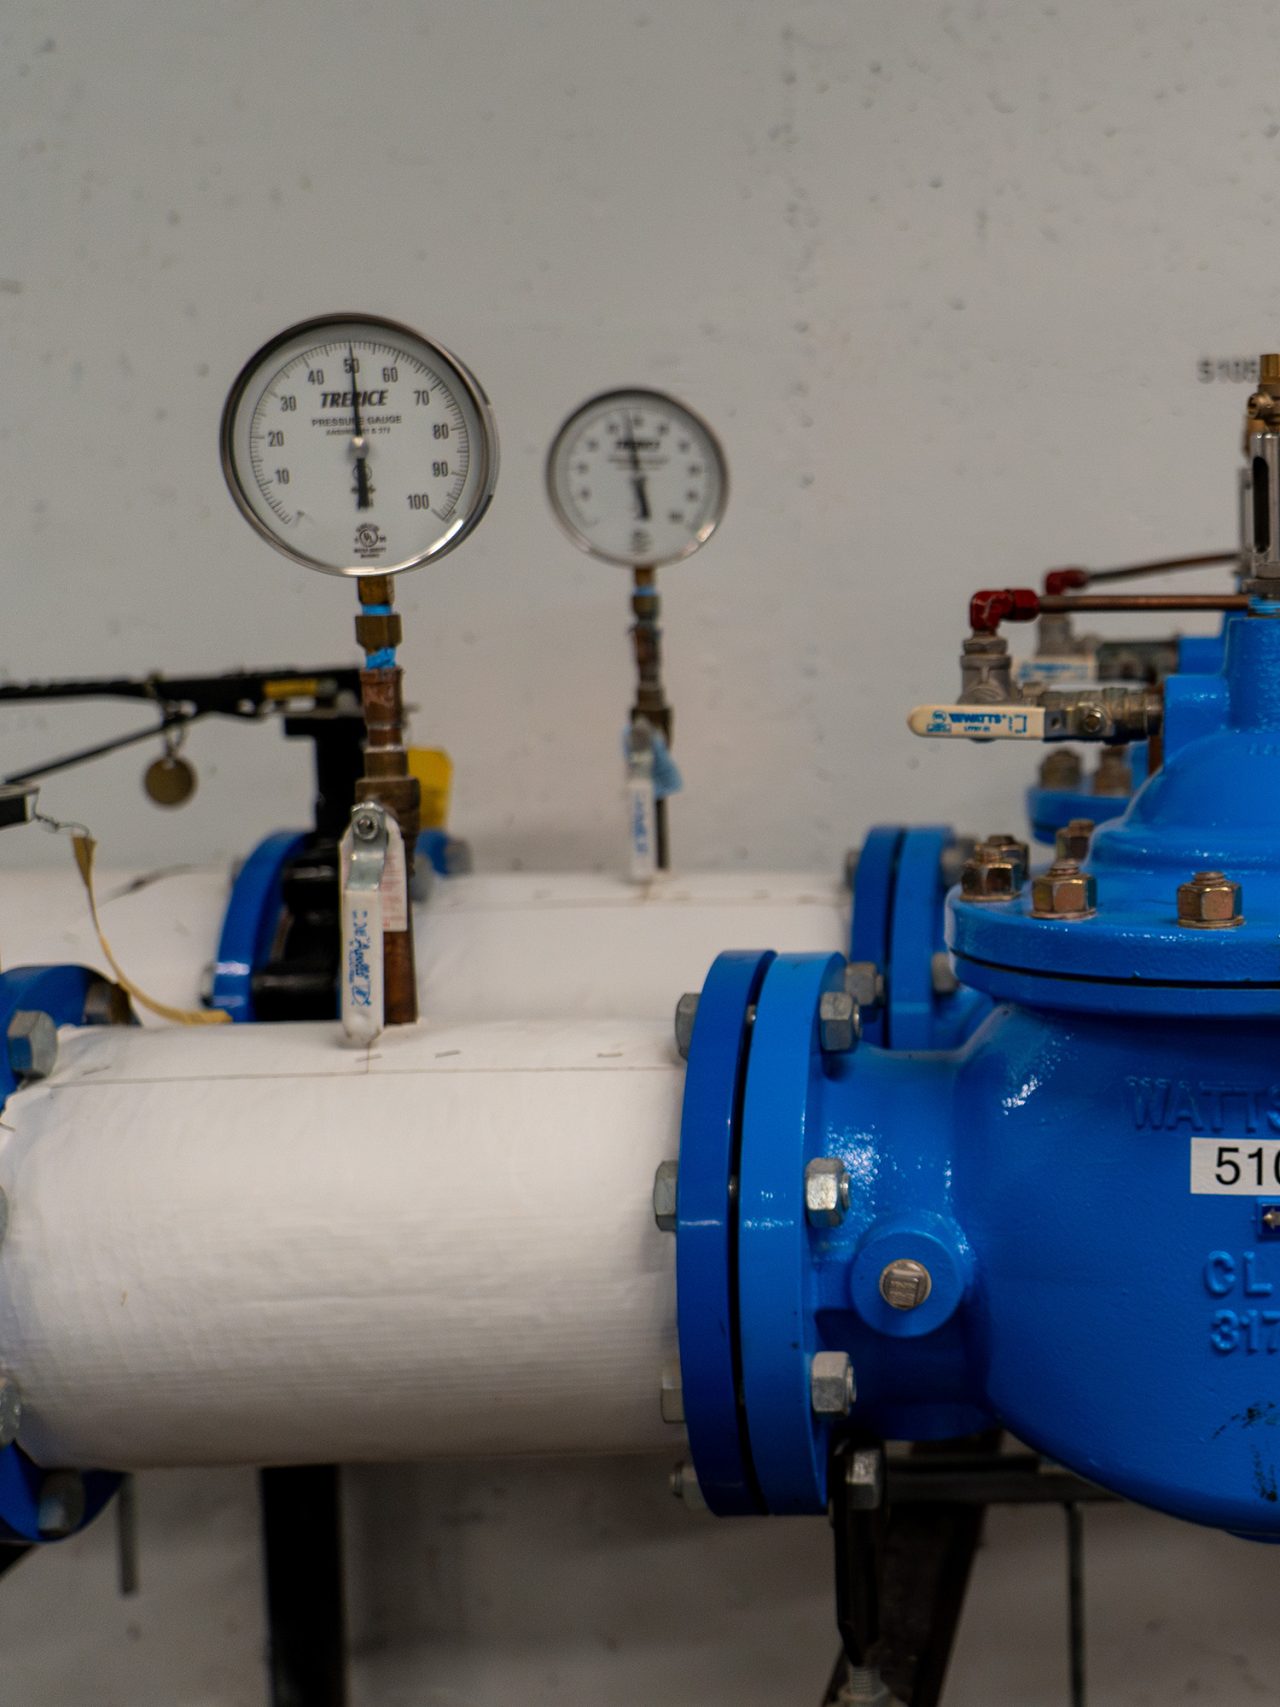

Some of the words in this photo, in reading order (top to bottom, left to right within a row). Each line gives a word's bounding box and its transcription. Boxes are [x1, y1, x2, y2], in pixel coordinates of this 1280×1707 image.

[308, 370, 324, 385] 40
[383, 367, 398, 383] 60
[281, 396, 296, 412] 30
[414, 391, 429, 406] 70
[312, 416, 364, 427] PRESSUE
[433, 424, 449, 439] 80
[268, 432, 284, 447] 20
[275, 469, 289, 484] 10
[408, 494, 429, 510] 100
